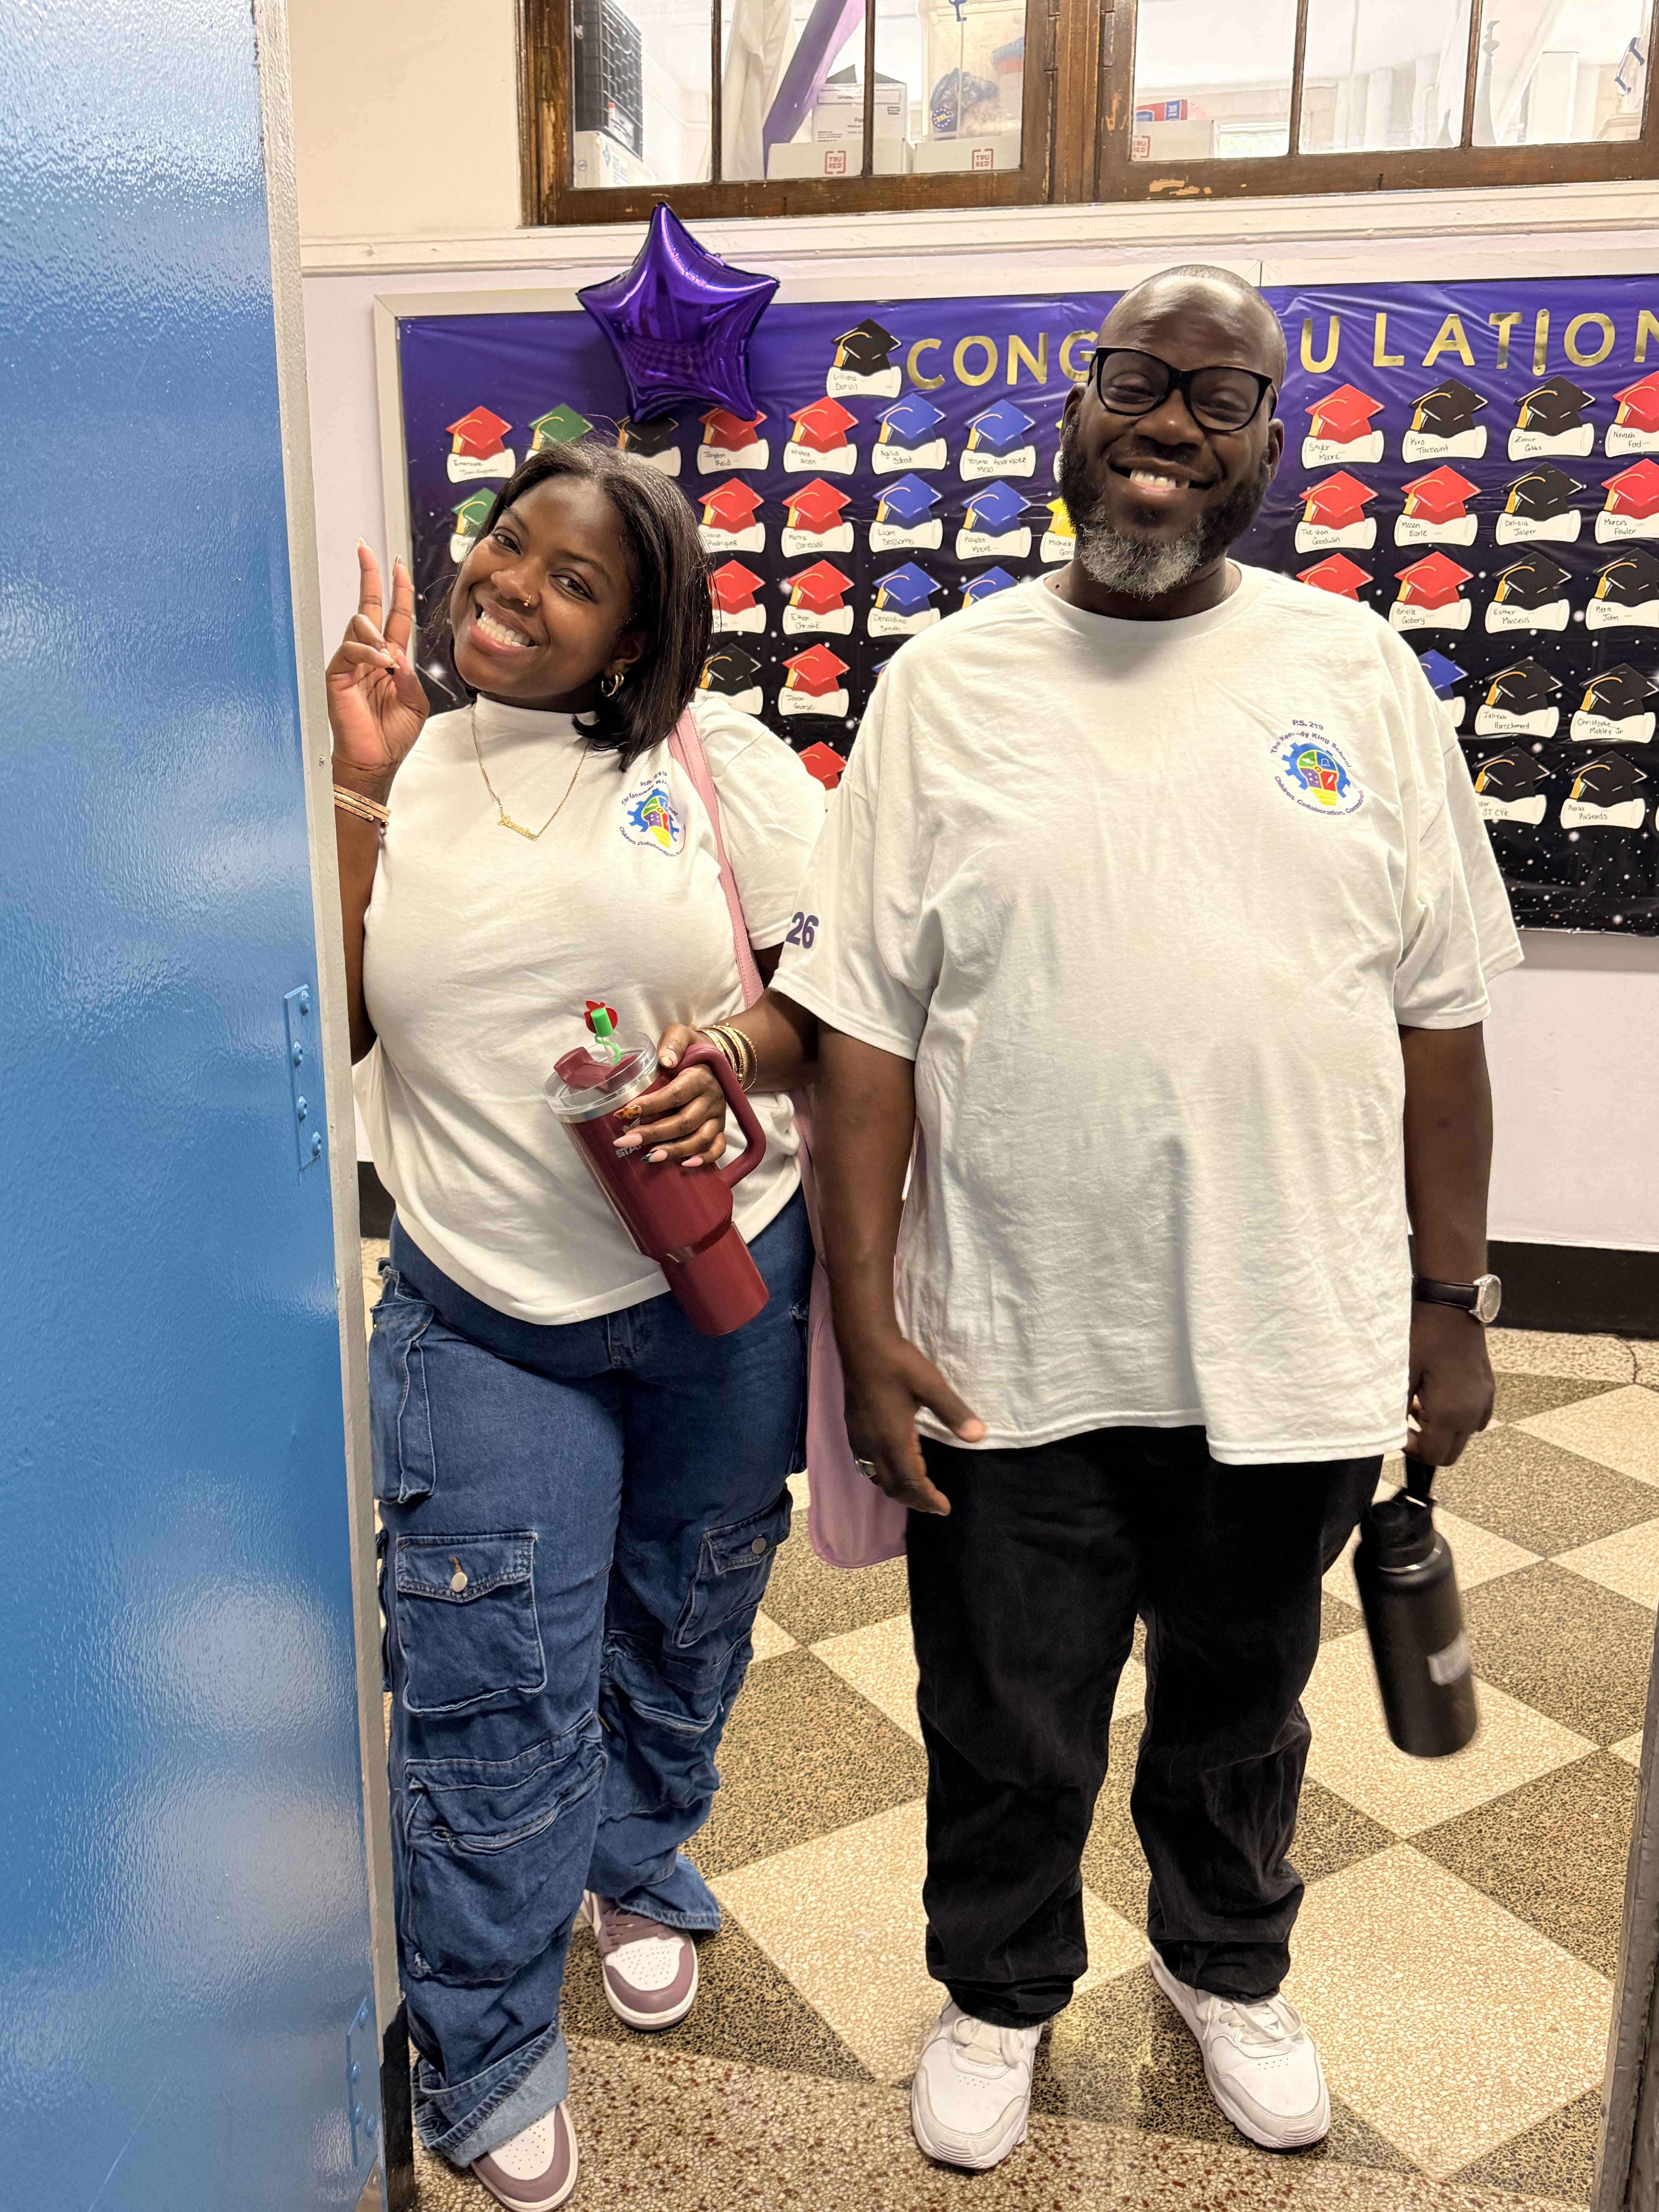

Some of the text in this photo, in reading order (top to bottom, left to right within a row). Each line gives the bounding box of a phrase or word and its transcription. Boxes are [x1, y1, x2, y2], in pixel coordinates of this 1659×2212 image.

[1416, 444, 1448, 454] Toussaint
[1514, 528, 1536, 536] Jasper
[1312, 537, 1340, 545] Goodwin
[1602, 613, 1618, 622] John
[1590, 727, 1612, 736] Mobley
[1271, 741, 1281, 754] The
[1312, 732, 1330, 744] King
[1331, 742, 1352, 768] School
[785, 911, 819, 949] 26
